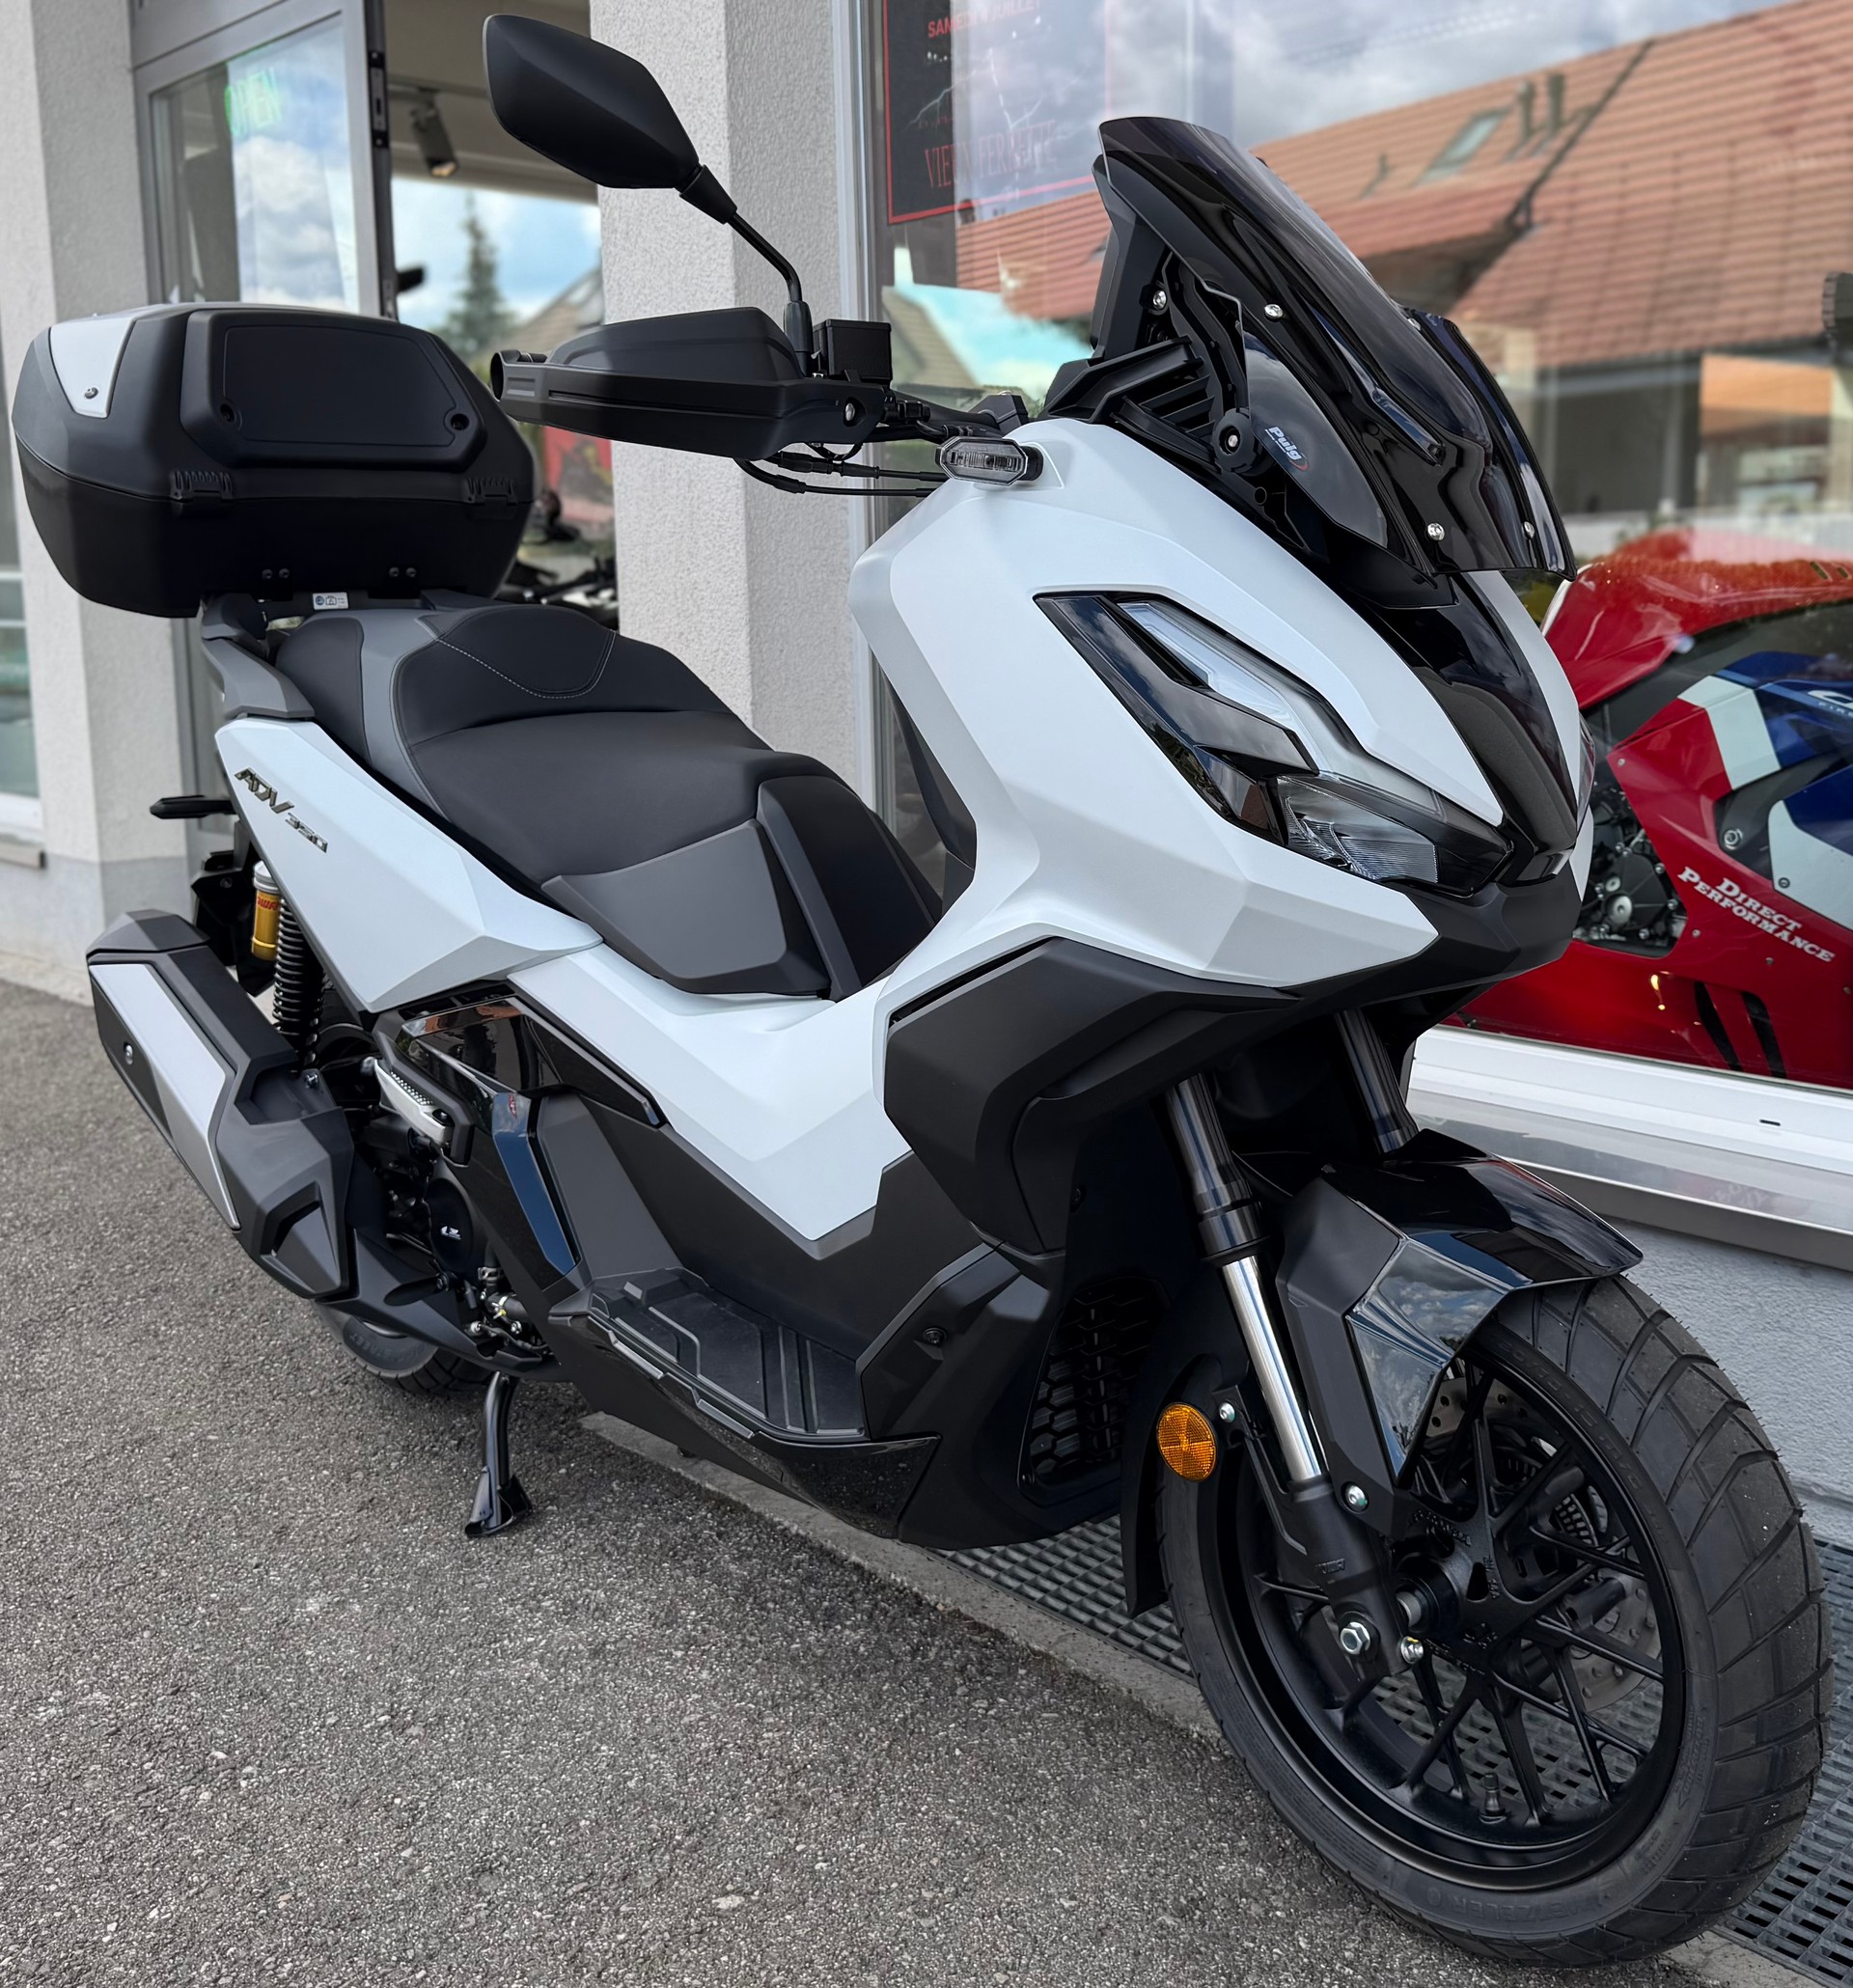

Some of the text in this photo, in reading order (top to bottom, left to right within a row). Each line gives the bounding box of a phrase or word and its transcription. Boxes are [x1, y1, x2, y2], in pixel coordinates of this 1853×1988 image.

[224, 68, 284, 137] OPEN
[1264, 426, 1303, 461] Puig
[234, 767, 295, 815] ADV
[1676, 866, 1837, 963] PERFORMANCE
[1715, 877, 1803, 932] DIRECT
